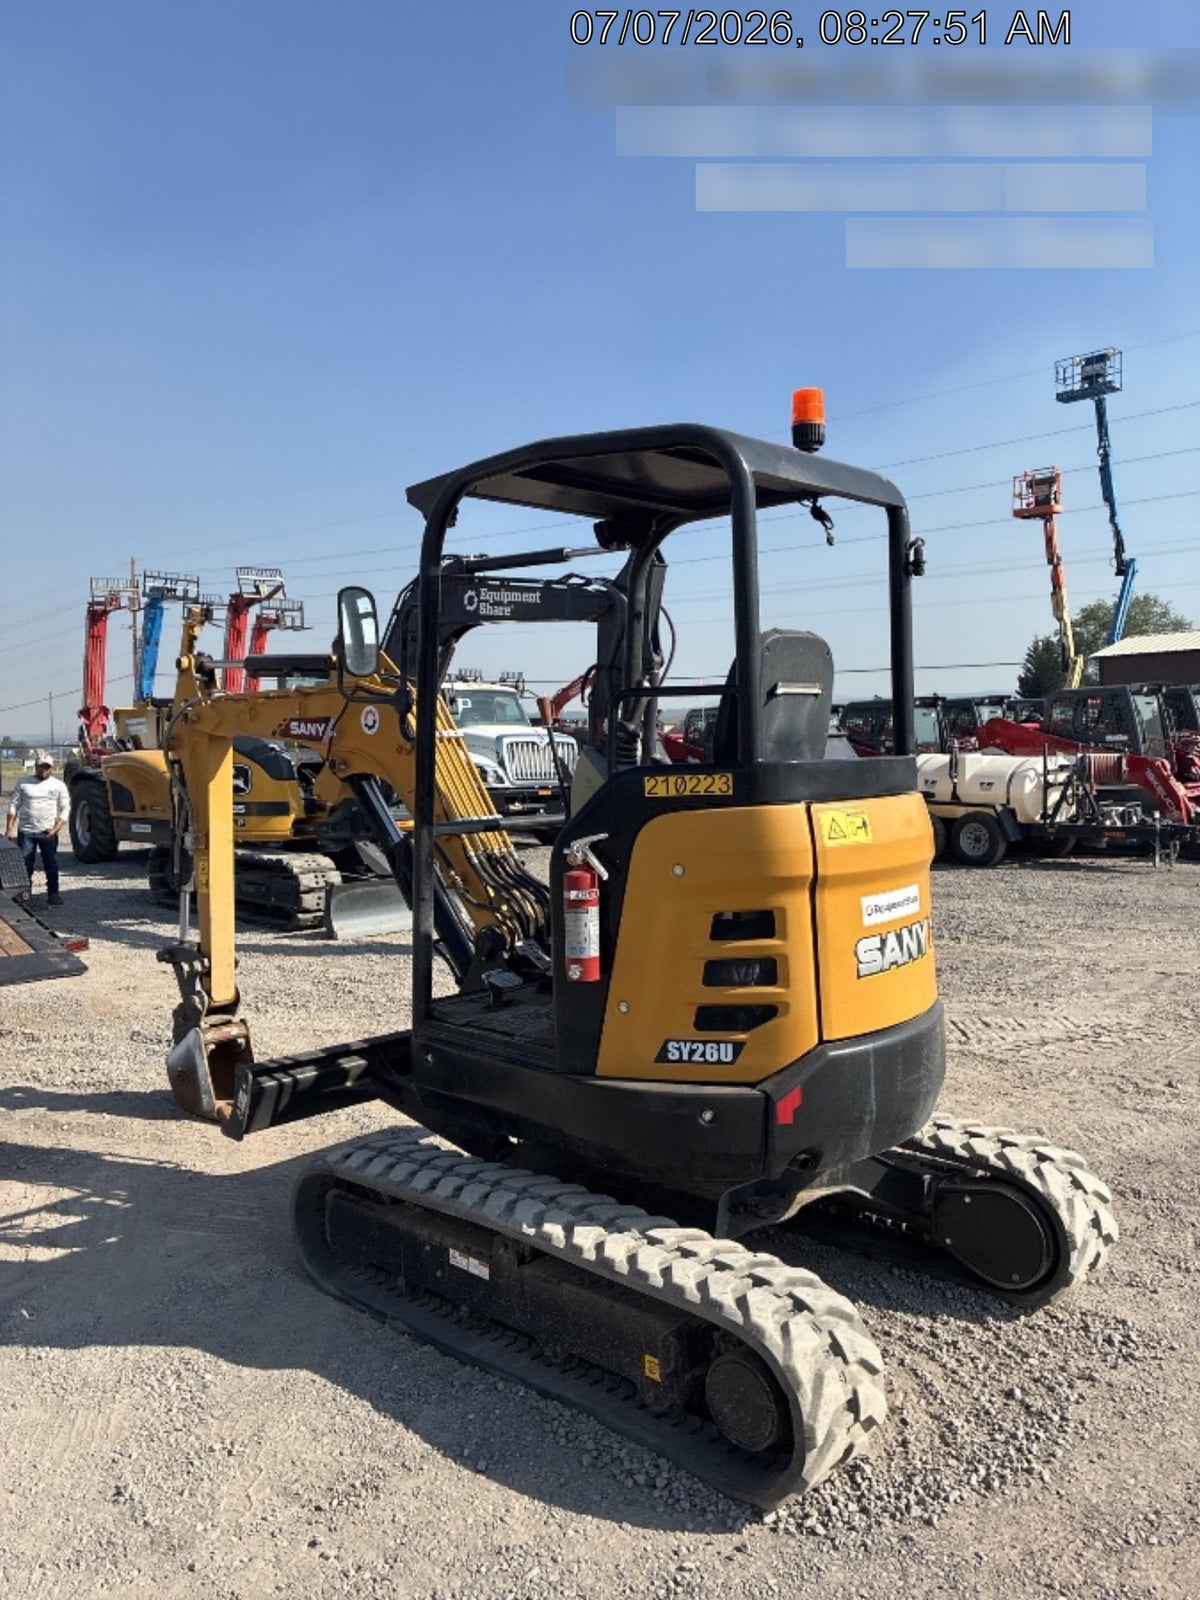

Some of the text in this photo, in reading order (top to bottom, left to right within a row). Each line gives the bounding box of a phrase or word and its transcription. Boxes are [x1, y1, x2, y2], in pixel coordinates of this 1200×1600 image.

[480, 588, 541, 604] Equipment
[480, 602, 511, 616] Share
[290, 721, 326, 736] SANY
[646, 774, 731, 795] 210223
[855, 916, 928, 979] SANY
[667, 1041, 734, 1062] SY26U
